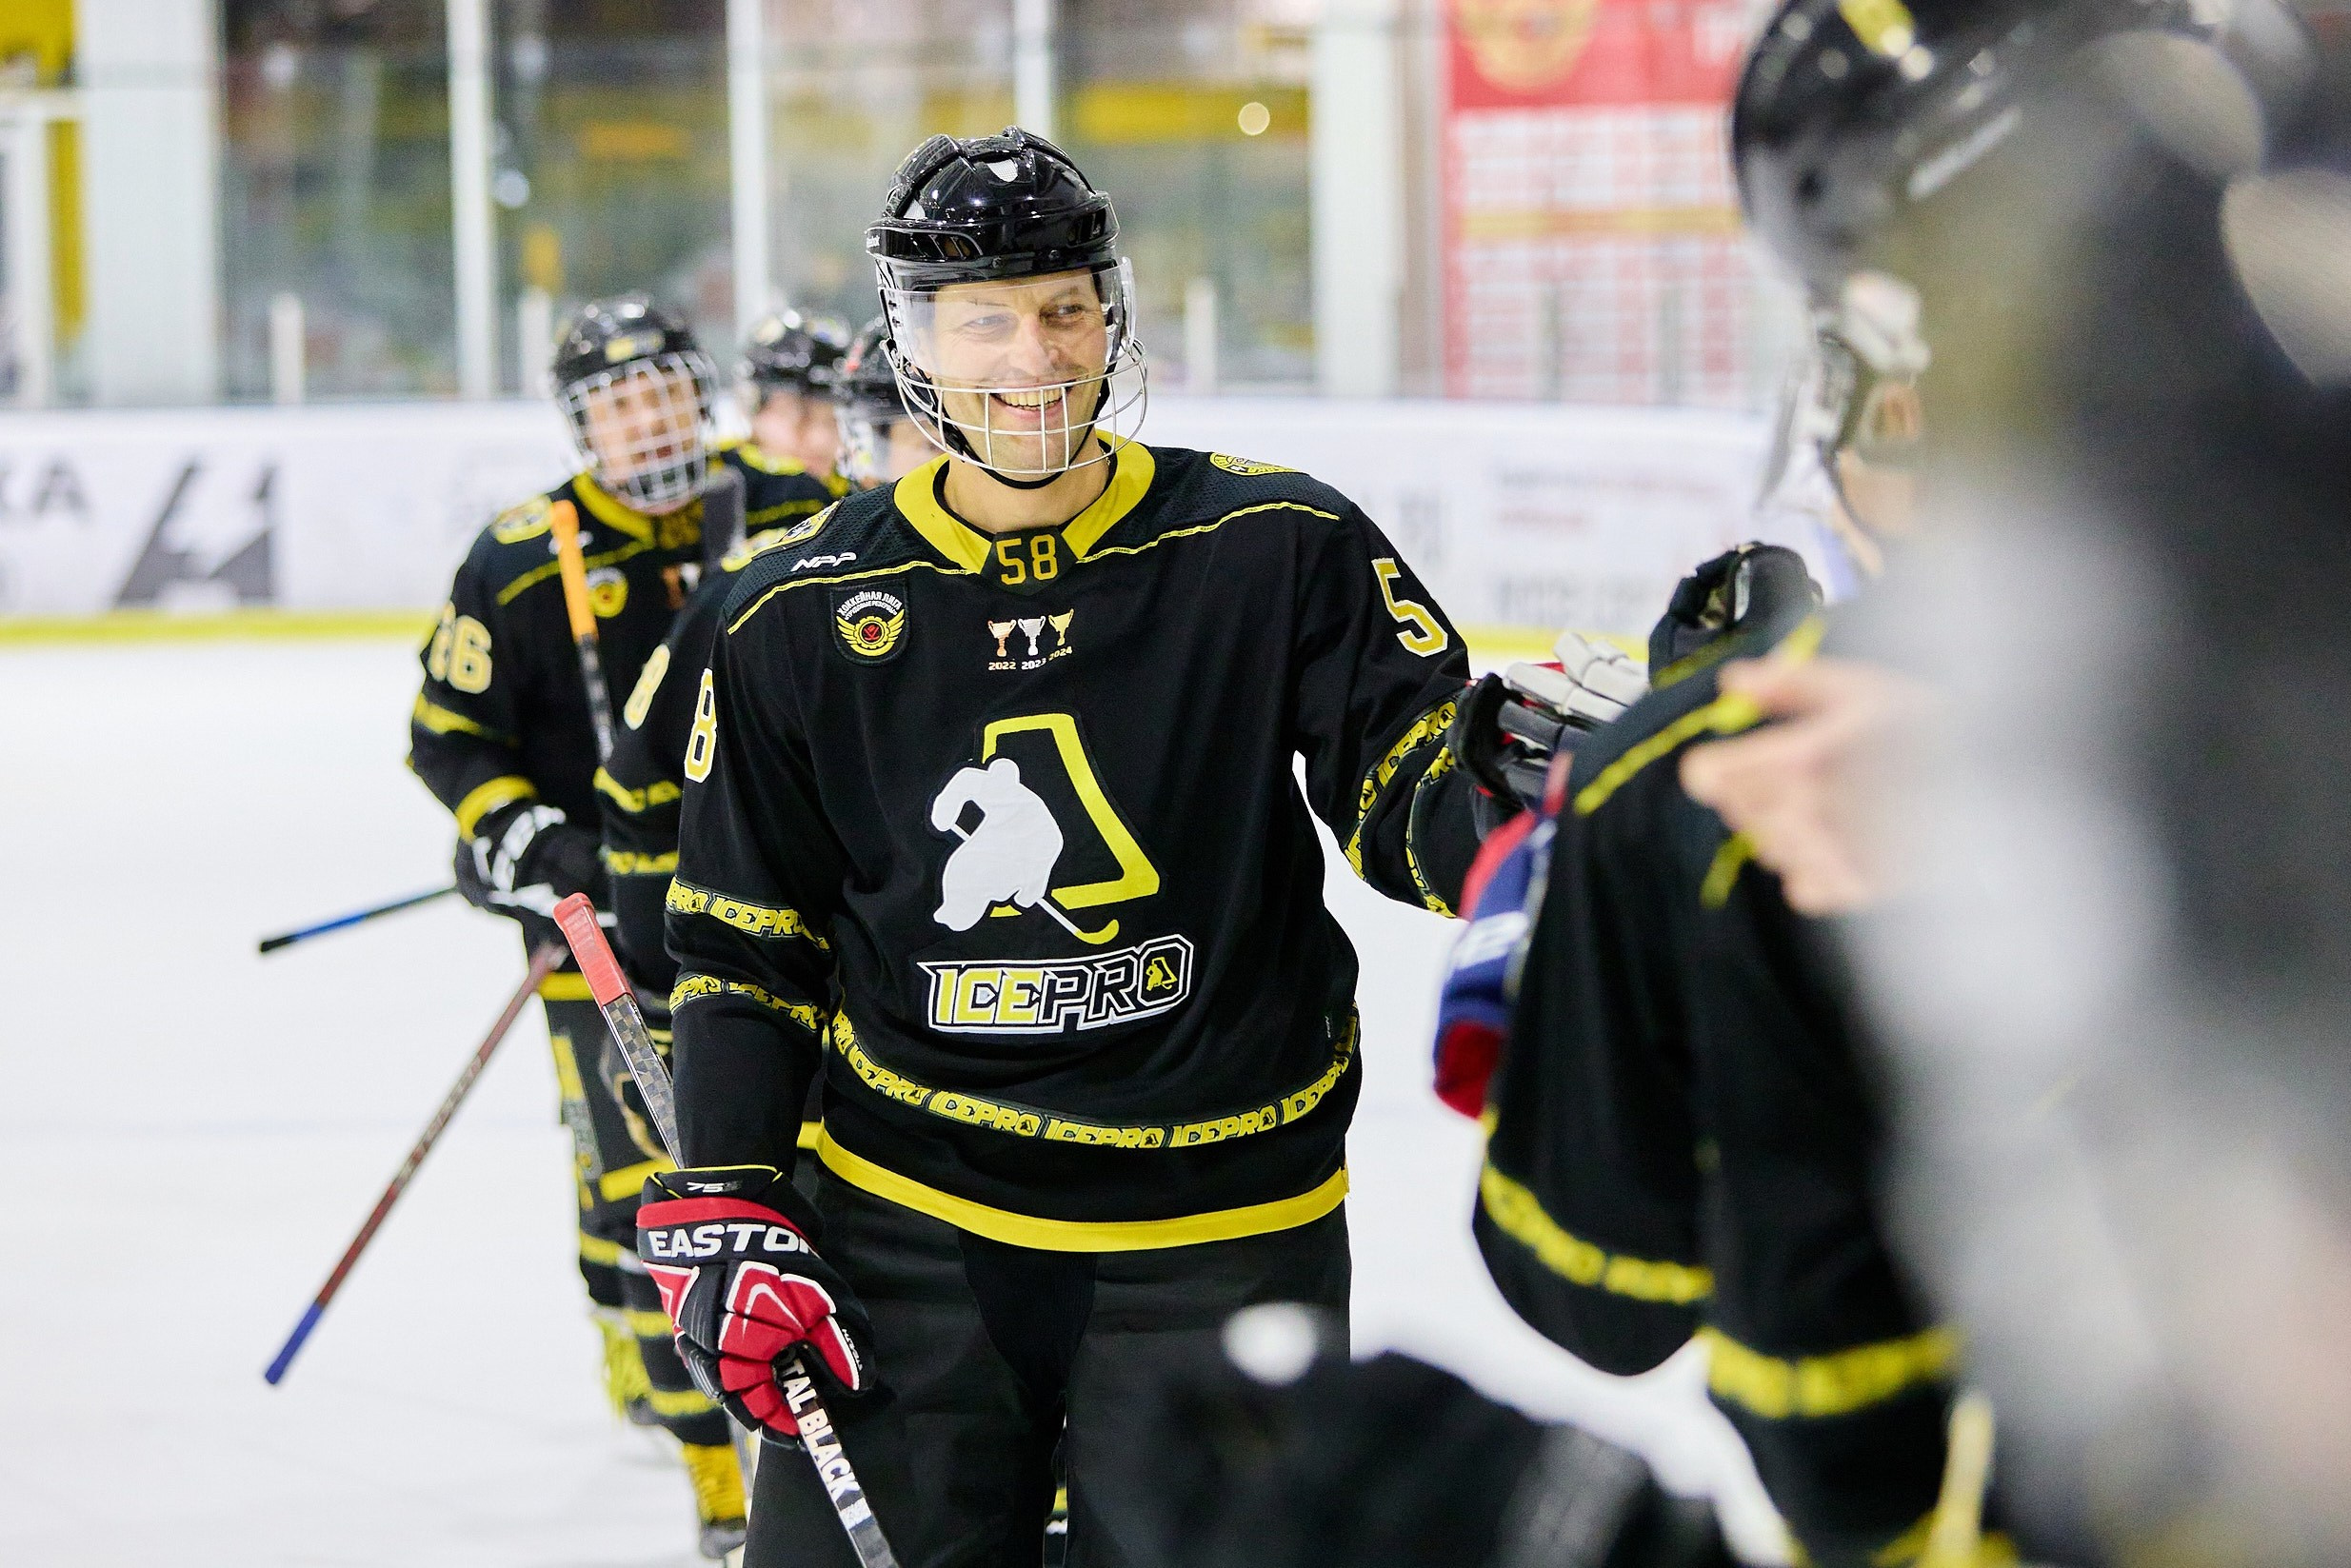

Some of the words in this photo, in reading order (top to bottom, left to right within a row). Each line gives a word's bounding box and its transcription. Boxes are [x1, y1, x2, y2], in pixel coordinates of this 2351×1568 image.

[791, 551, 857, 572] NPP
[837, 591, 883, 616] ХОККЕЙНАЯ
[881, 593, 903, 610] ЛИГА
[995, 533, 1059, 586] 58
[1371, 557, 1448, 658] 5
[988, 661, 1016, 671] 2022
[1021, 657, 1047, 670] 2023
[1048, 645, 1073, 662] 2024
[684, 667, 718, 784] 8
[922, 937, 1192, 1031] ICEPRO
[848, 1044, 932, 1105] ICEPRO
[928, 1091, 1043, 1138] ICEPRO
[1044, 1118, 1167, 1149] ICEPRO
[1168, 1105, 1277, 1148] ICEPRO
[797, 1407, 862, 1503] BLACK
